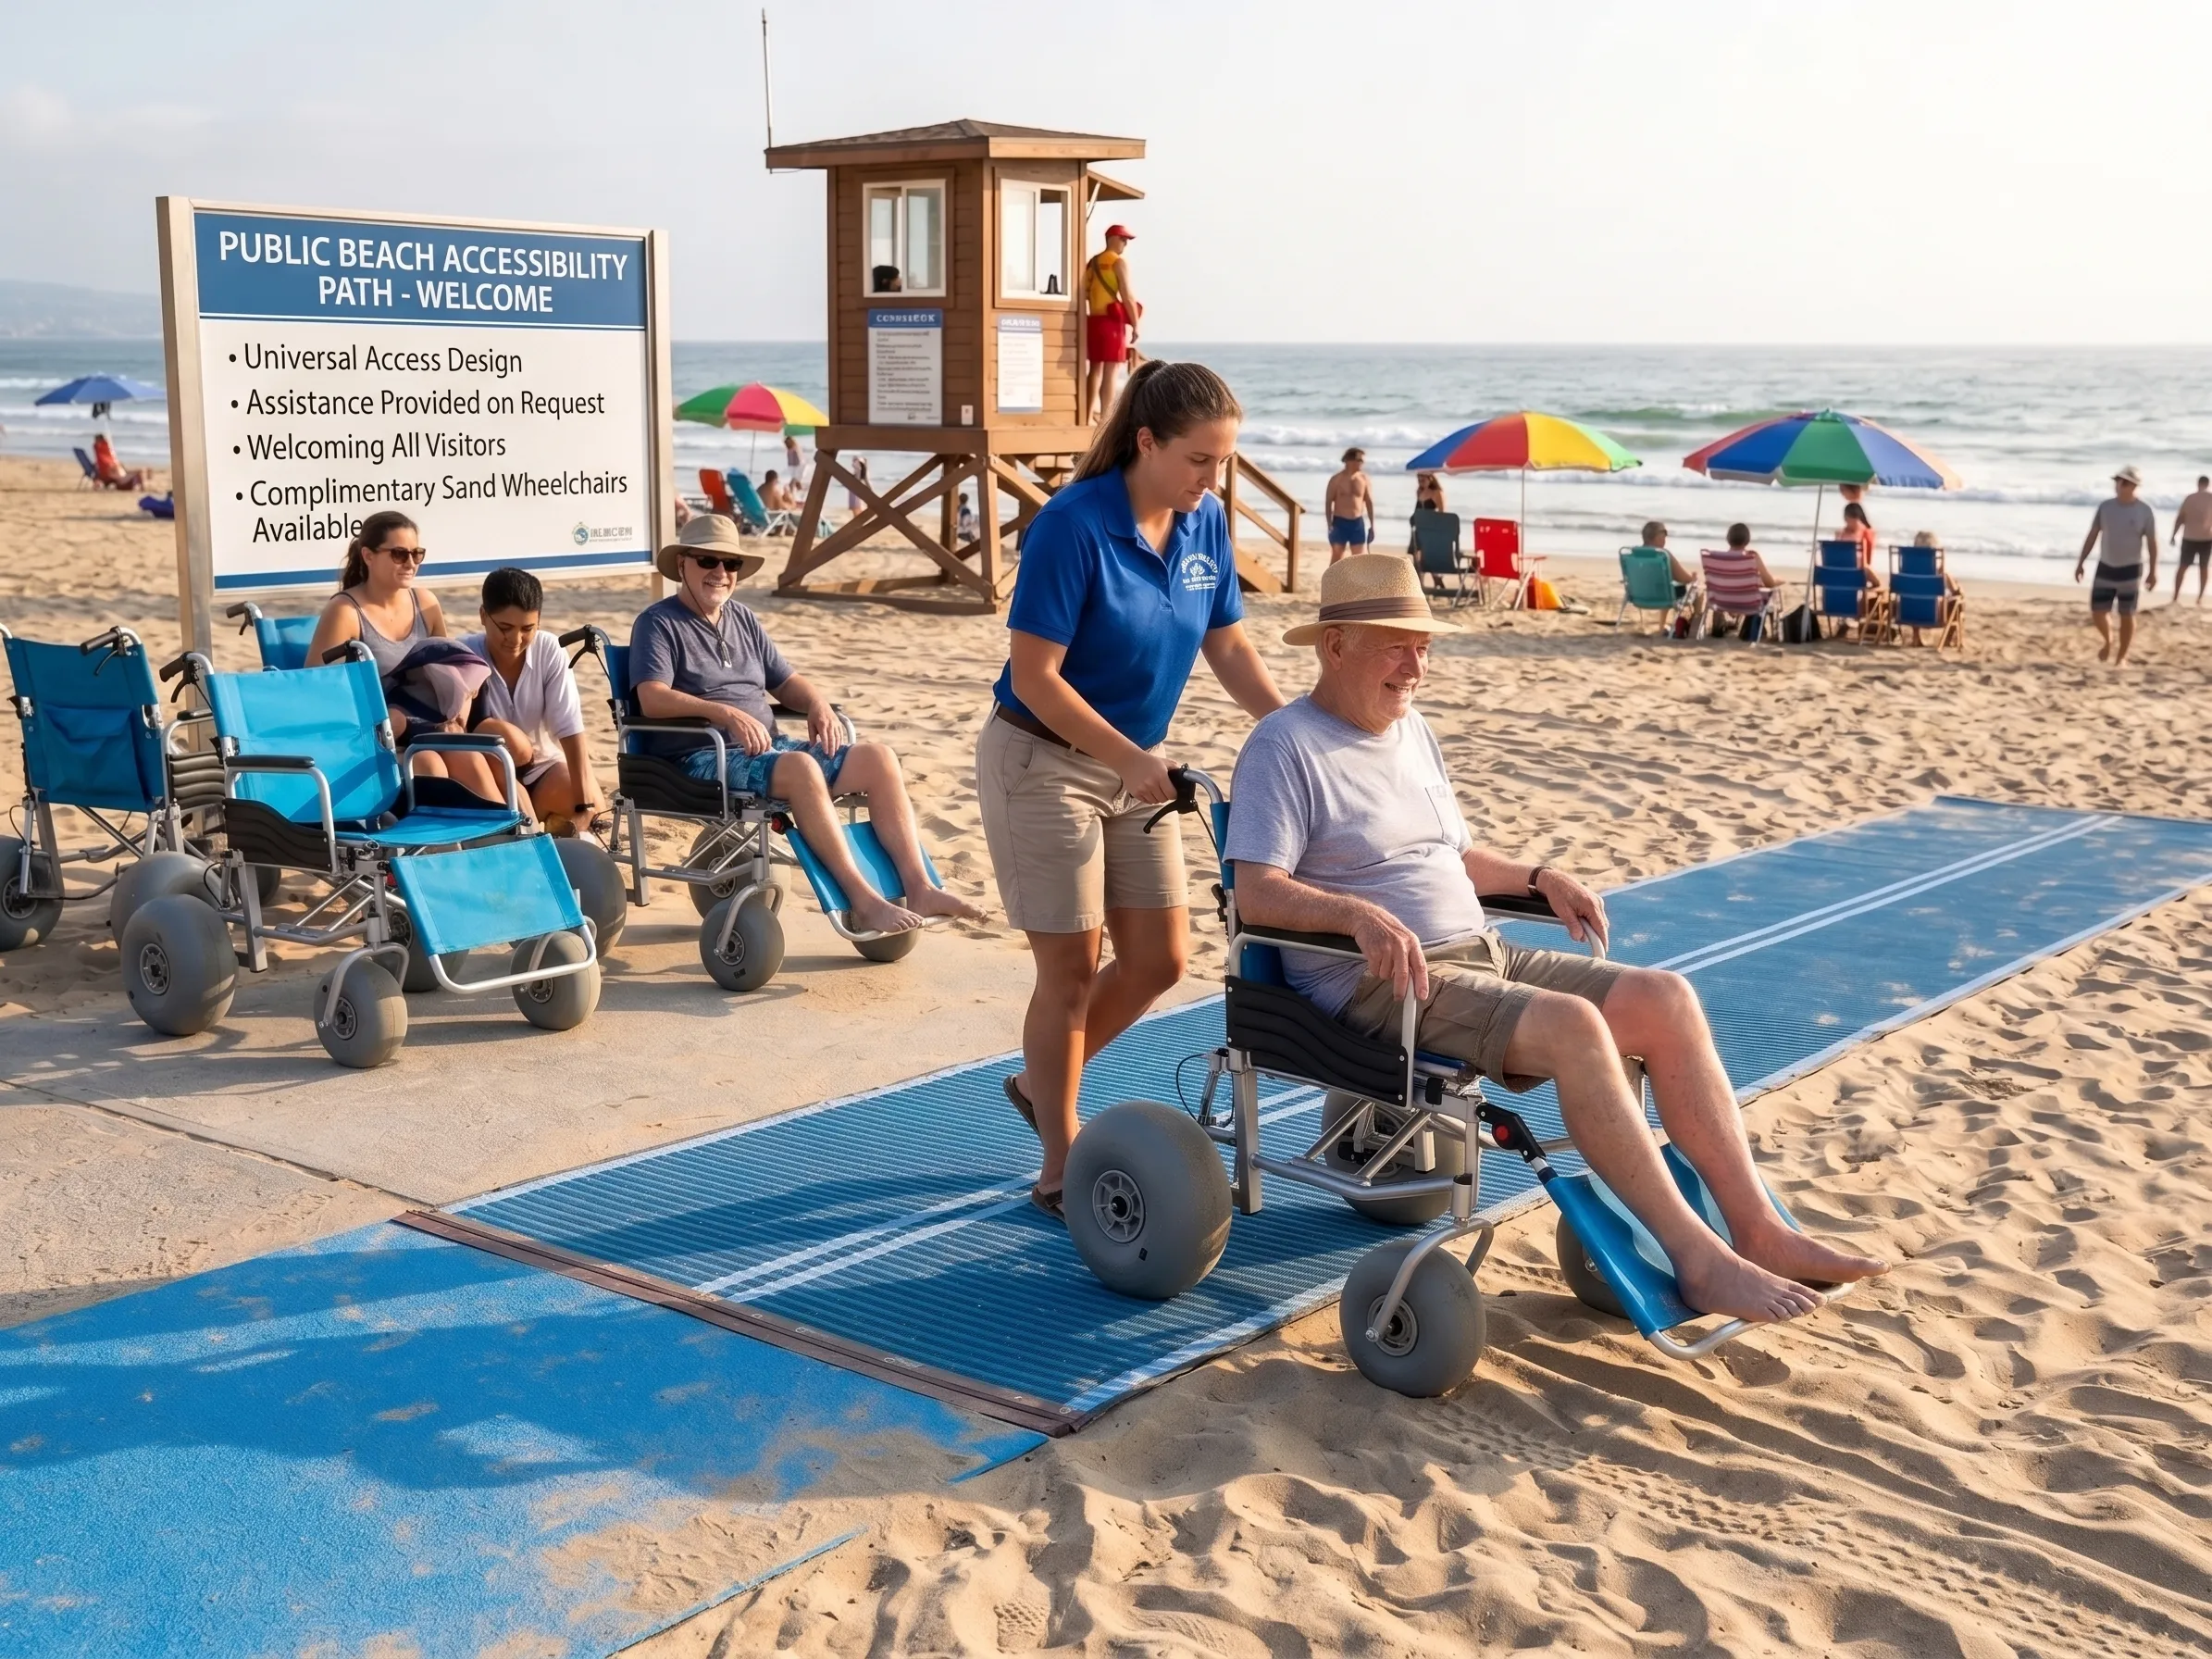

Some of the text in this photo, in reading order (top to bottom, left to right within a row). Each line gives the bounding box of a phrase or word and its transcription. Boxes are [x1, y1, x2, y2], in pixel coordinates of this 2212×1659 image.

[219, 231, 628, 281] PUBLIC BEACH ACCESSIBILITY
[318, 275, 392, 307] PATH
[416, 279, 553, 313] WELCOME
[244, 343, 523, 379] Universal Access Design
[246, 388, 605, 421] Assistance Provided on Request
[246, 431, 506, 466] Welcoming All Visitors
[250, 470, 628, 512] Complimentary Sand Wheelchairs
[252, 512, 364, 543] Available
